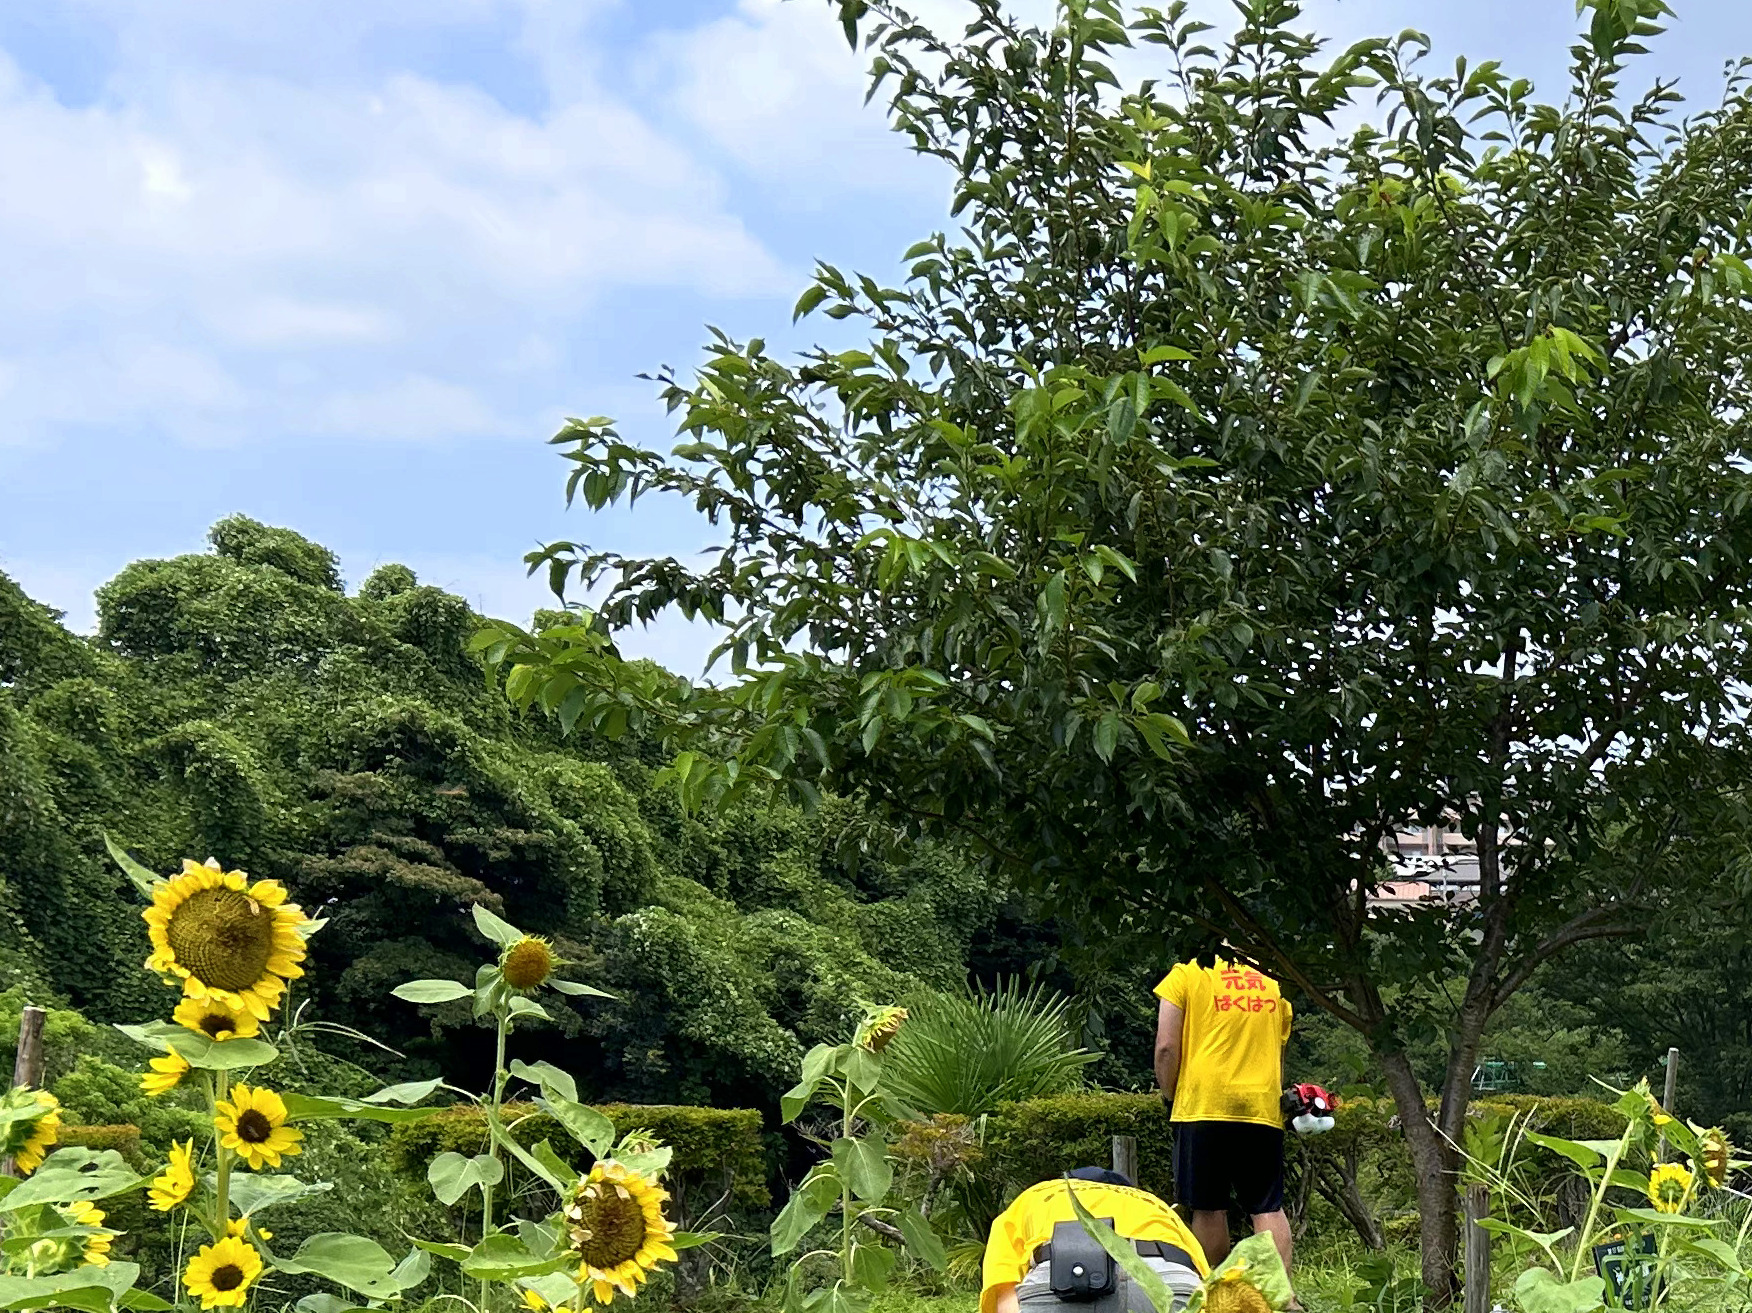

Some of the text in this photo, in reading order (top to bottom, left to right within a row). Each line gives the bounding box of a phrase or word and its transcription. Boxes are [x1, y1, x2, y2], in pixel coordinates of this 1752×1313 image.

[1221, 970, 1266, 991] 元気
[1214, 994, 1276, 1013] ばくはつ
